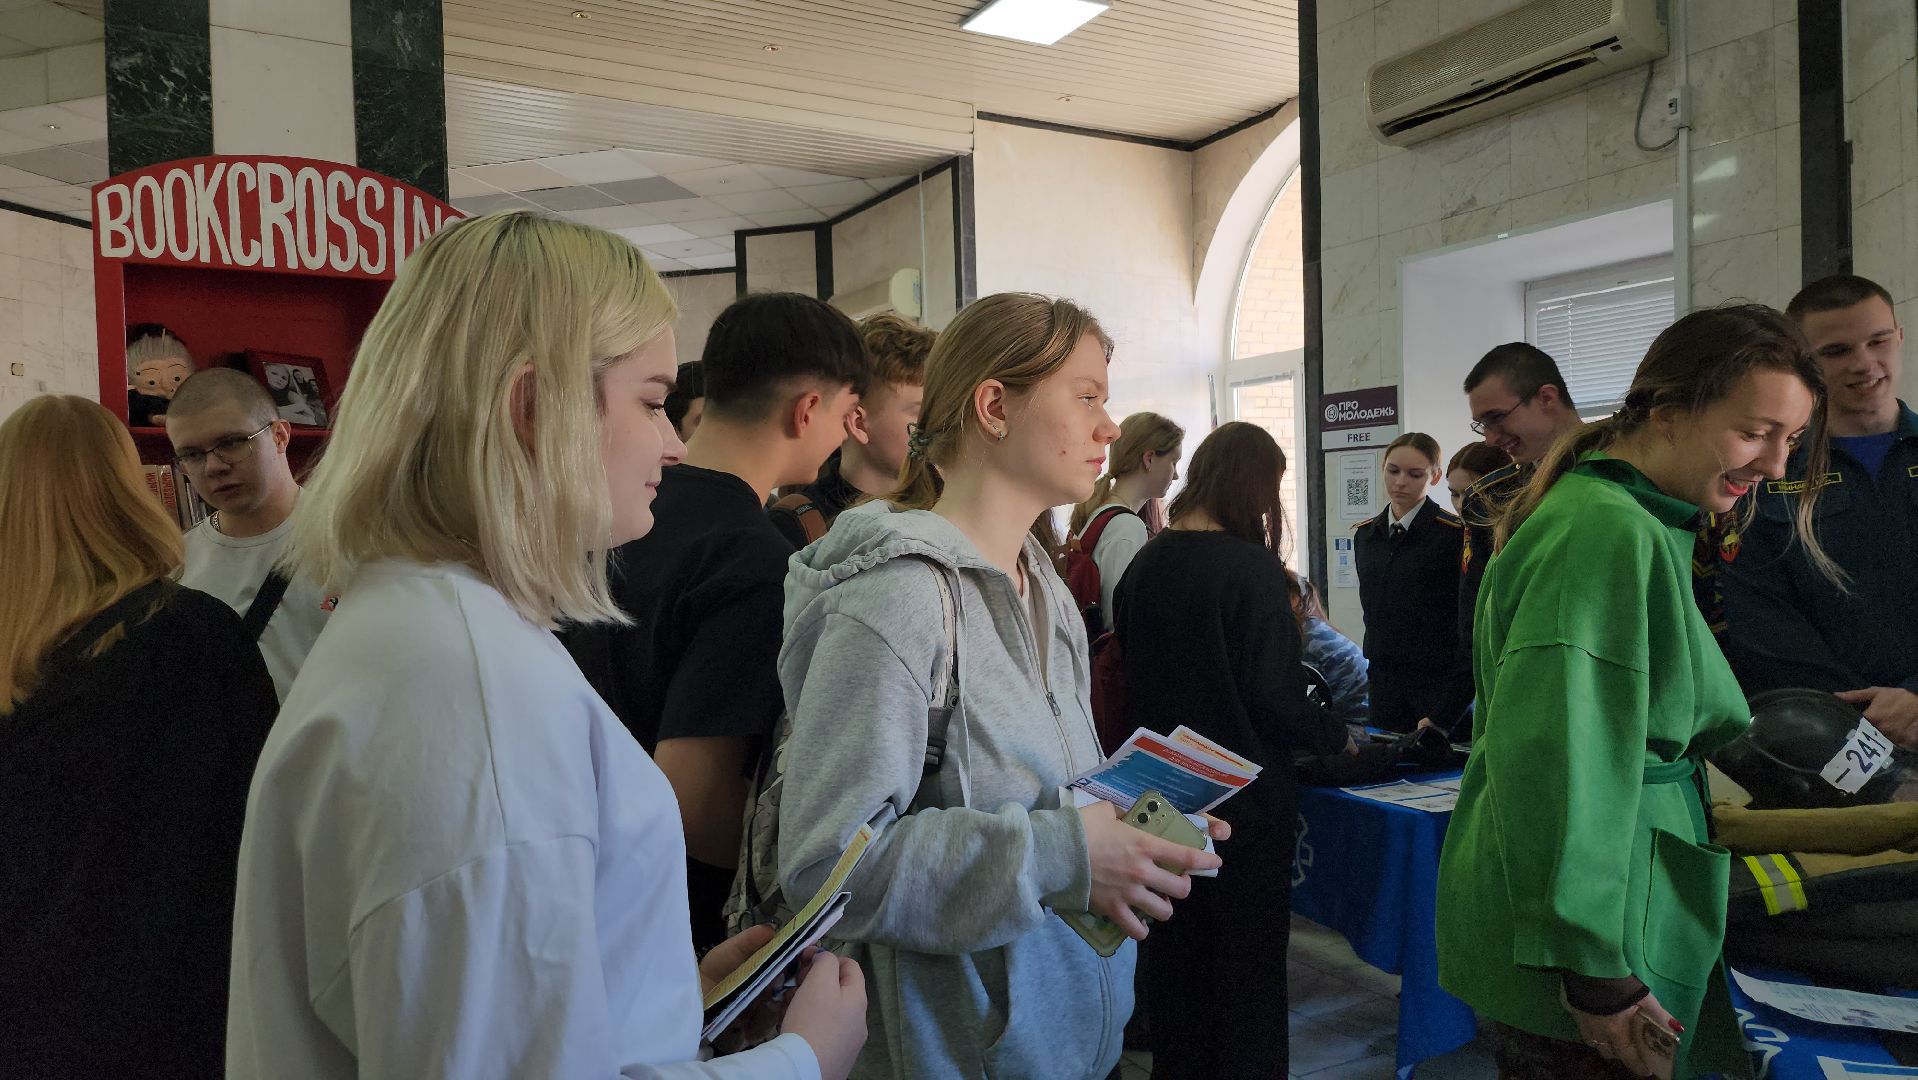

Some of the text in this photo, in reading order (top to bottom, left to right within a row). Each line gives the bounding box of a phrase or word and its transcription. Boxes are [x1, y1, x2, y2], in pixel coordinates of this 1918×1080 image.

[97, 162, 463, 275] BOOKCROSSIN
[1338, 400, 1359, 411] ПРО
[1338, 406, 1395, 422] МОЛОДЕЖЬ
[1347, 432, 1371, 443] FREE
